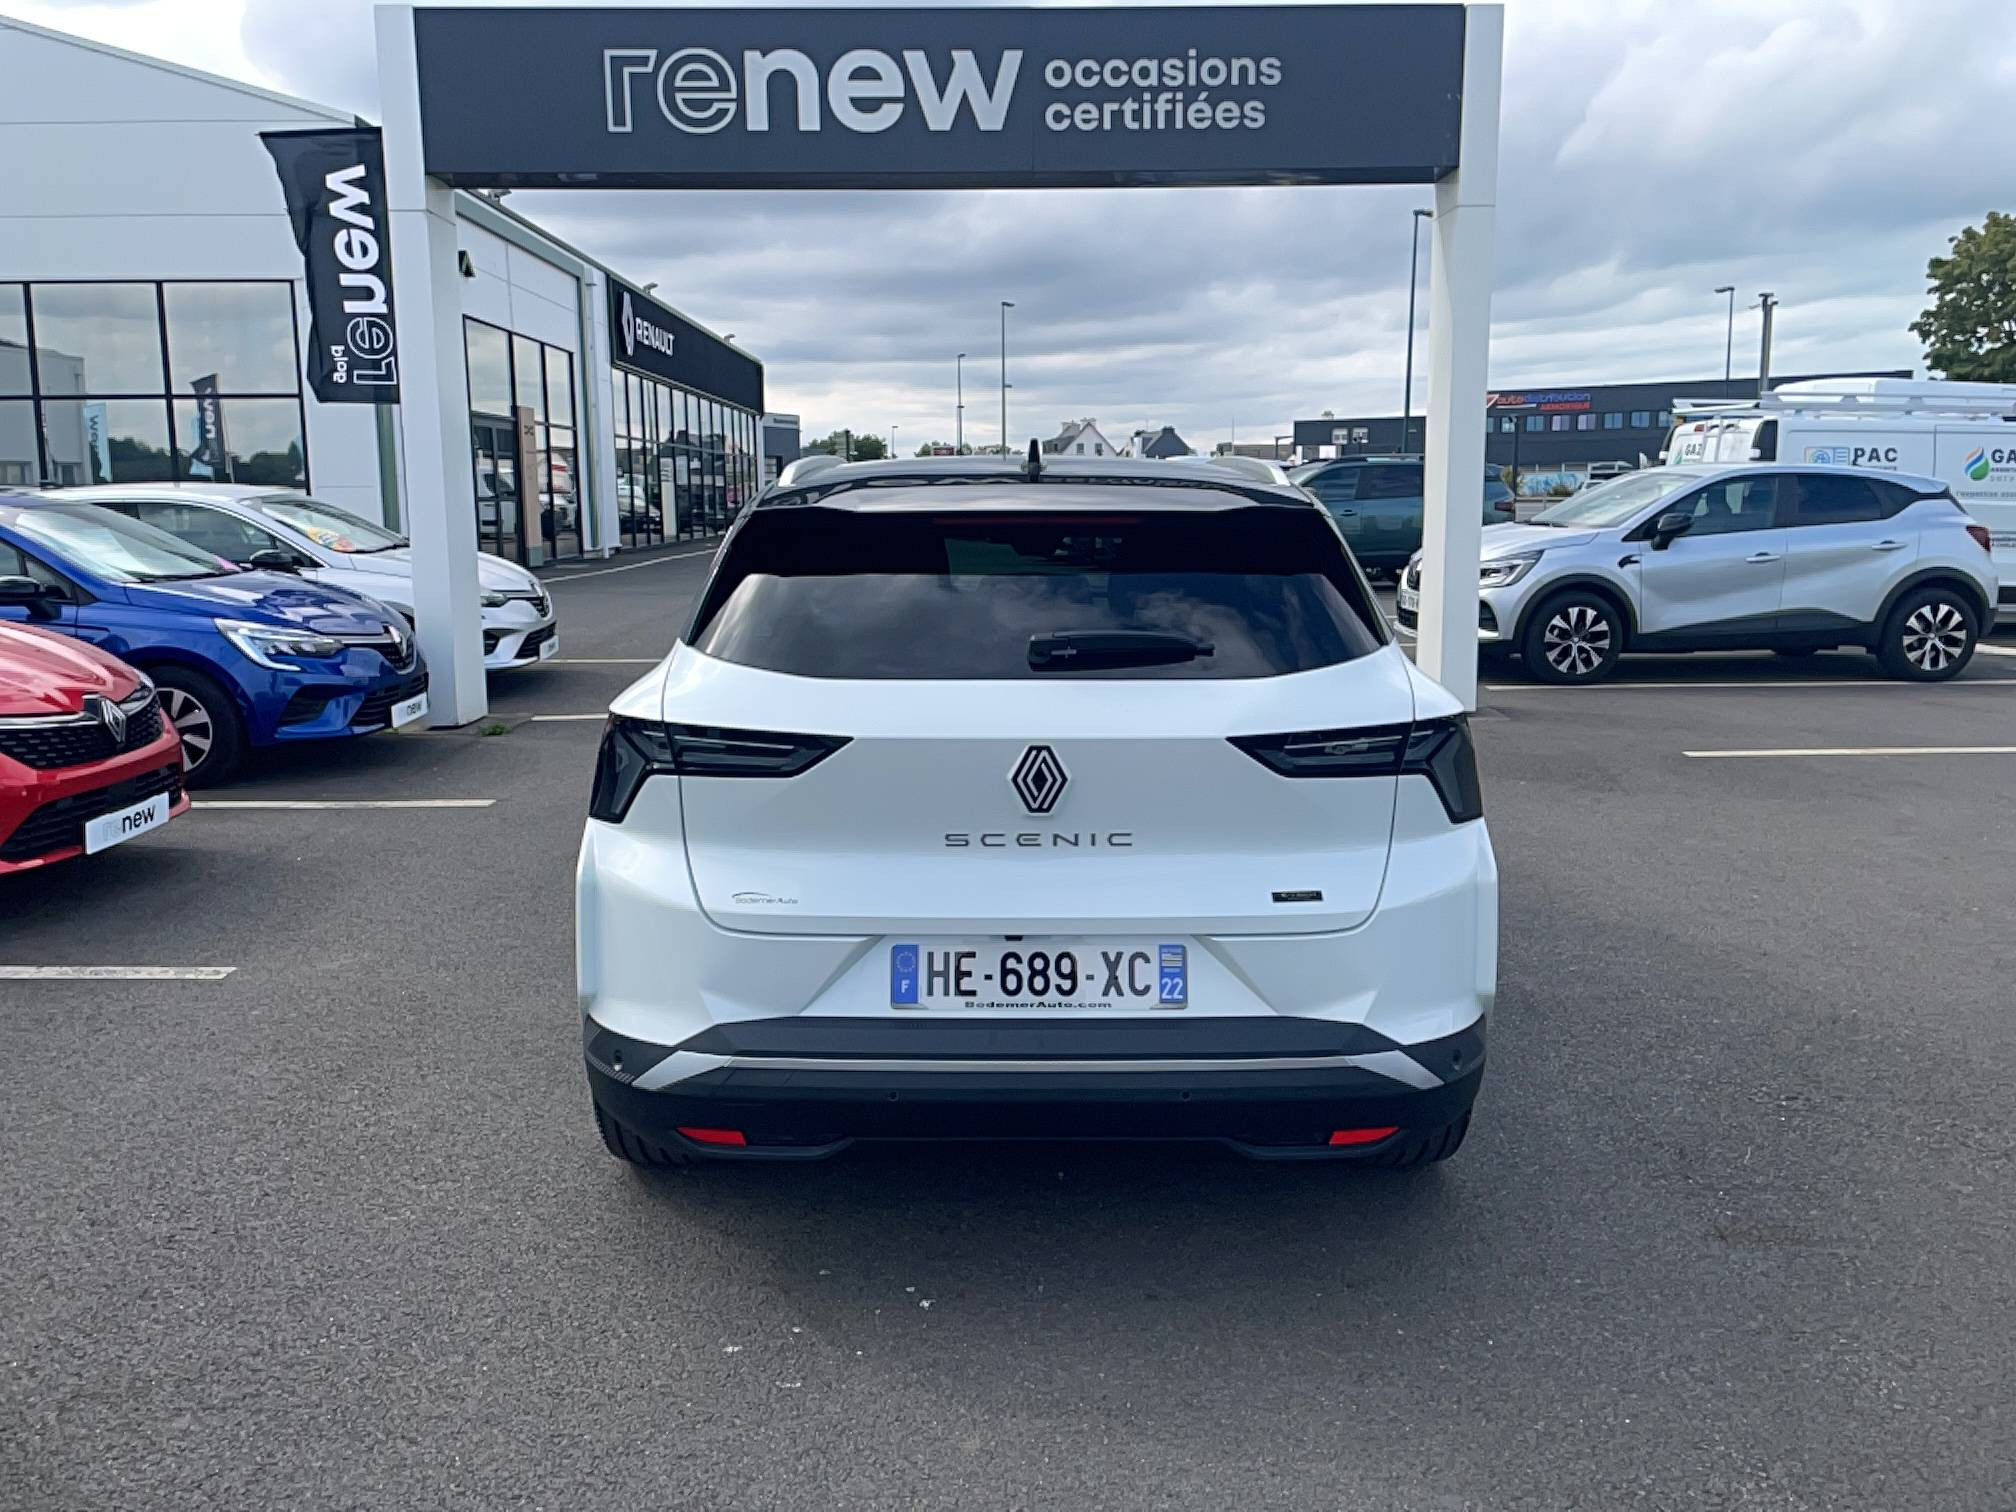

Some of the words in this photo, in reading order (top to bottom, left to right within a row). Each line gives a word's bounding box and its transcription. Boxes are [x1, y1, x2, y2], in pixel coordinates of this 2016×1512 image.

[1044, 48, 1282, 88] occasions
[603, 48, 1023, 133] renew
[1044, 91, 1266, 132] certifiées
[635, 316, 675, 357] RENAULT
[1852, 447, 1898, 466] PAC
[944, 832, 1133, 847] SCENIC
[901, 979, 910, 993] F
[926, 951, 1152, 997] HE-689-XC
[1161, 977, 1184, 999] 22
[964, 1001, 1113, 1009] BodemerAuto.com
